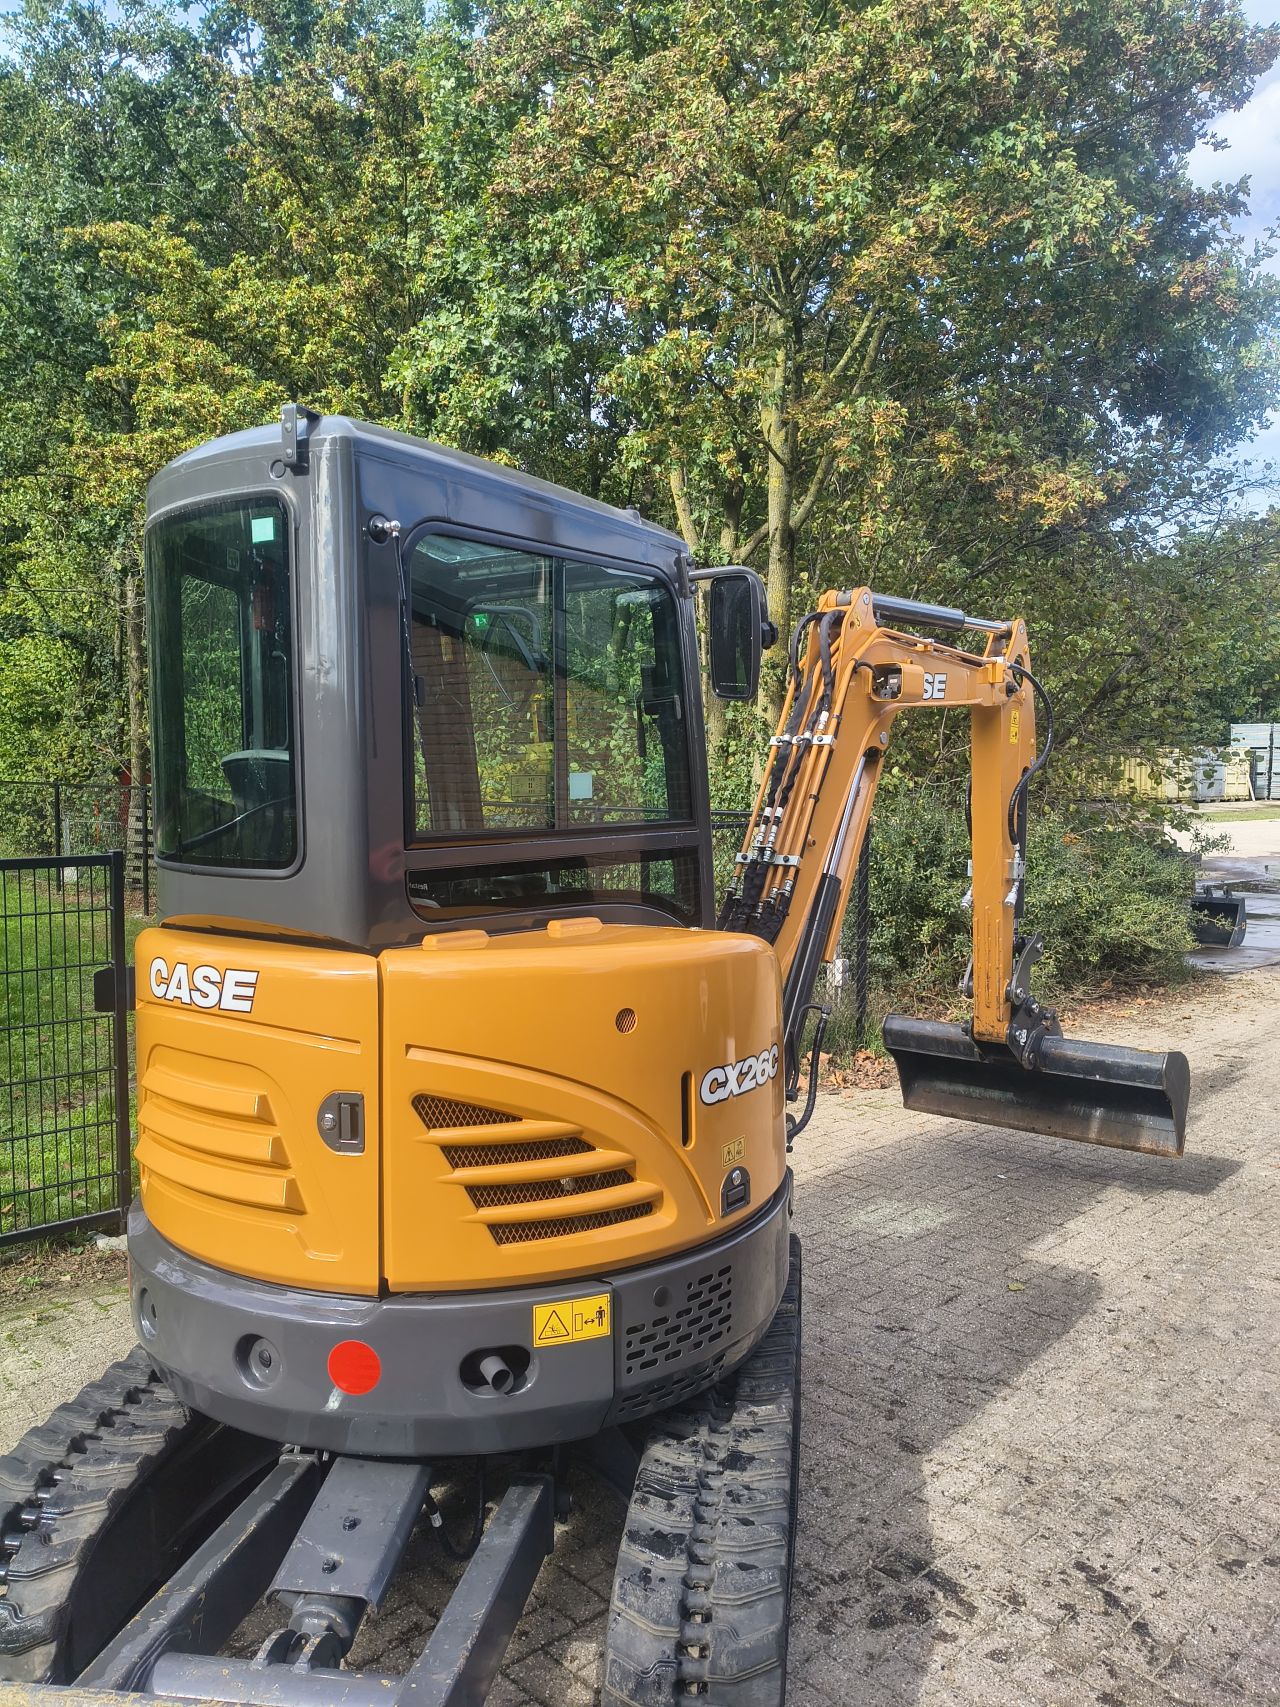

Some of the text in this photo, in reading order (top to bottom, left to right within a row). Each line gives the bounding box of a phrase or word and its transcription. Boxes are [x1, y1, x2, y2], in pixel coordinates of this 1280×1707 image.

[922, 672, 948, 700] SE
[150, 957, 260, 1013] CASE
[700, 1043, 780, 1106] CX26C
